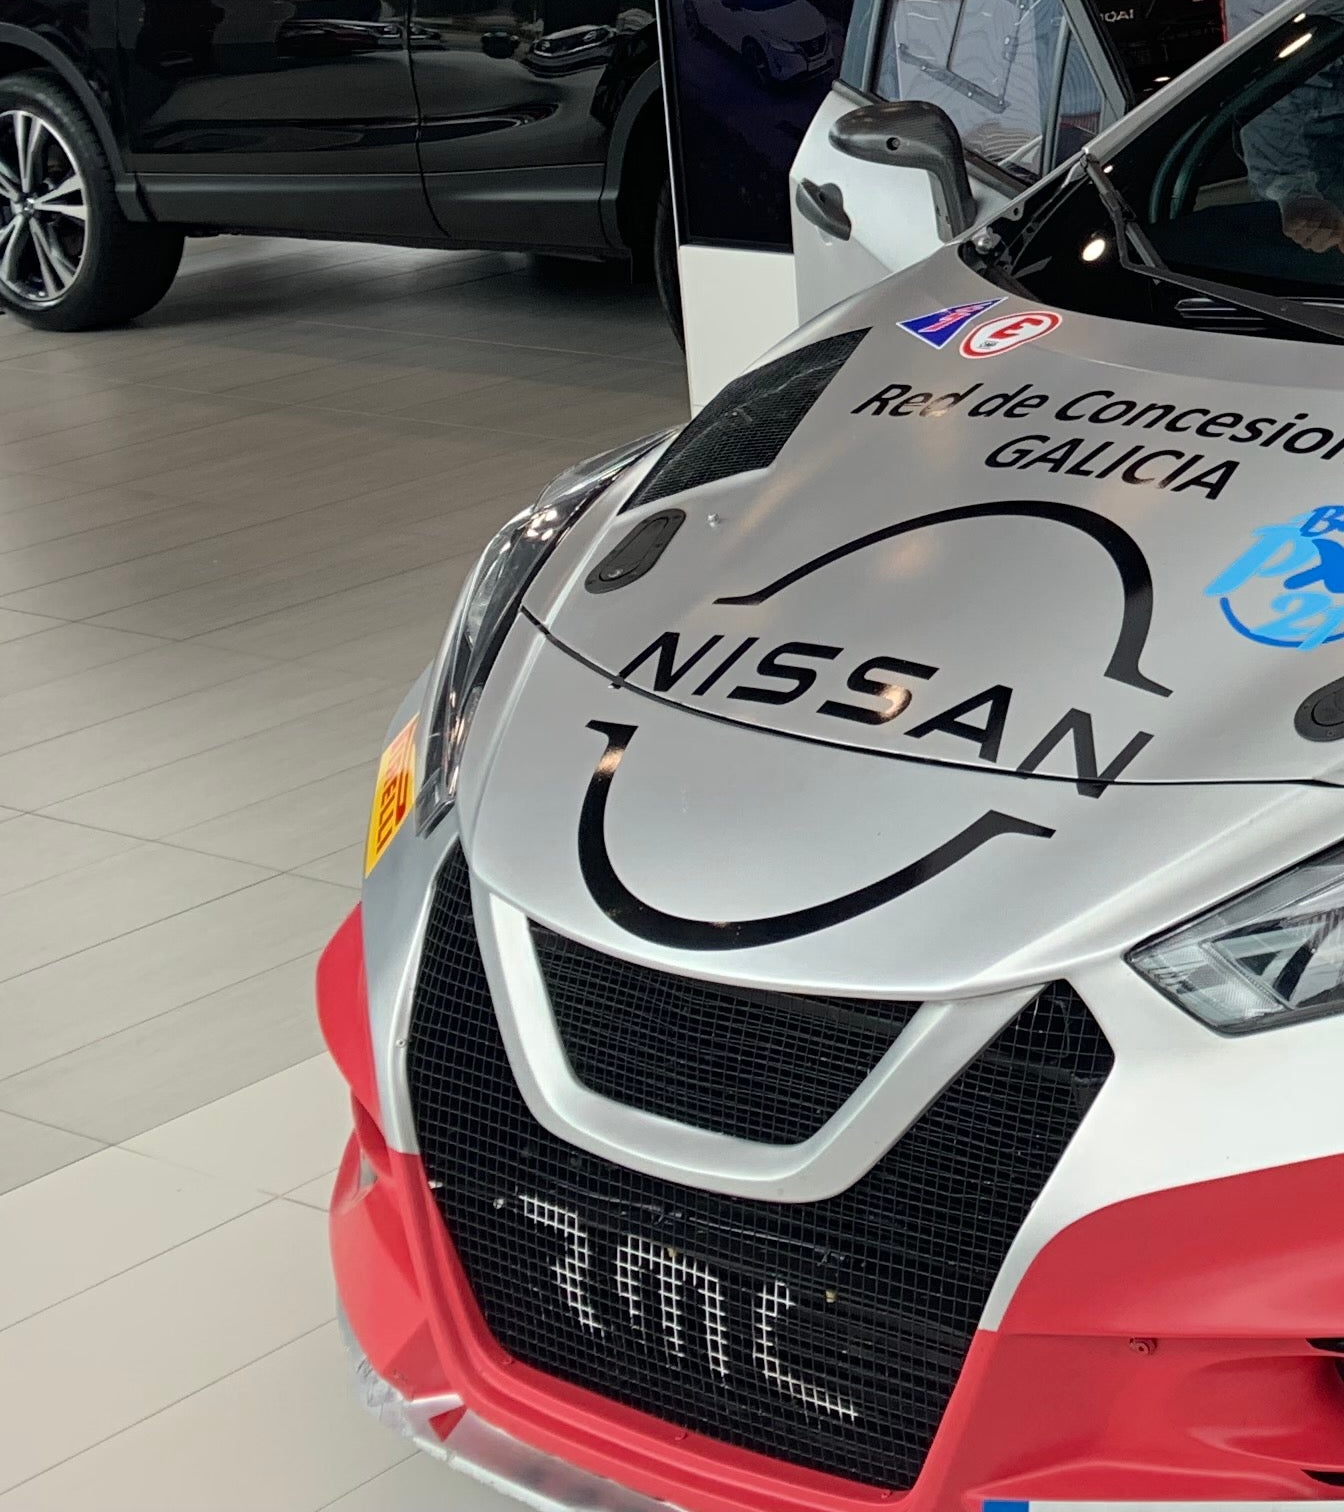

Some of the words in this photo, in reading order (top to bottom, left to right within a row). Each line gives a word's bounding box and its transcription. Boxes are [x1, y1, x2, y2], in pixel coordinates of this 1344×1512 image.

[851, 382, 978, 419] Red
[968, 383, 1049, 419] de
[982, 433, 1241, 502] GALICIA
[608, 630, 1155, 800] NISSAN
